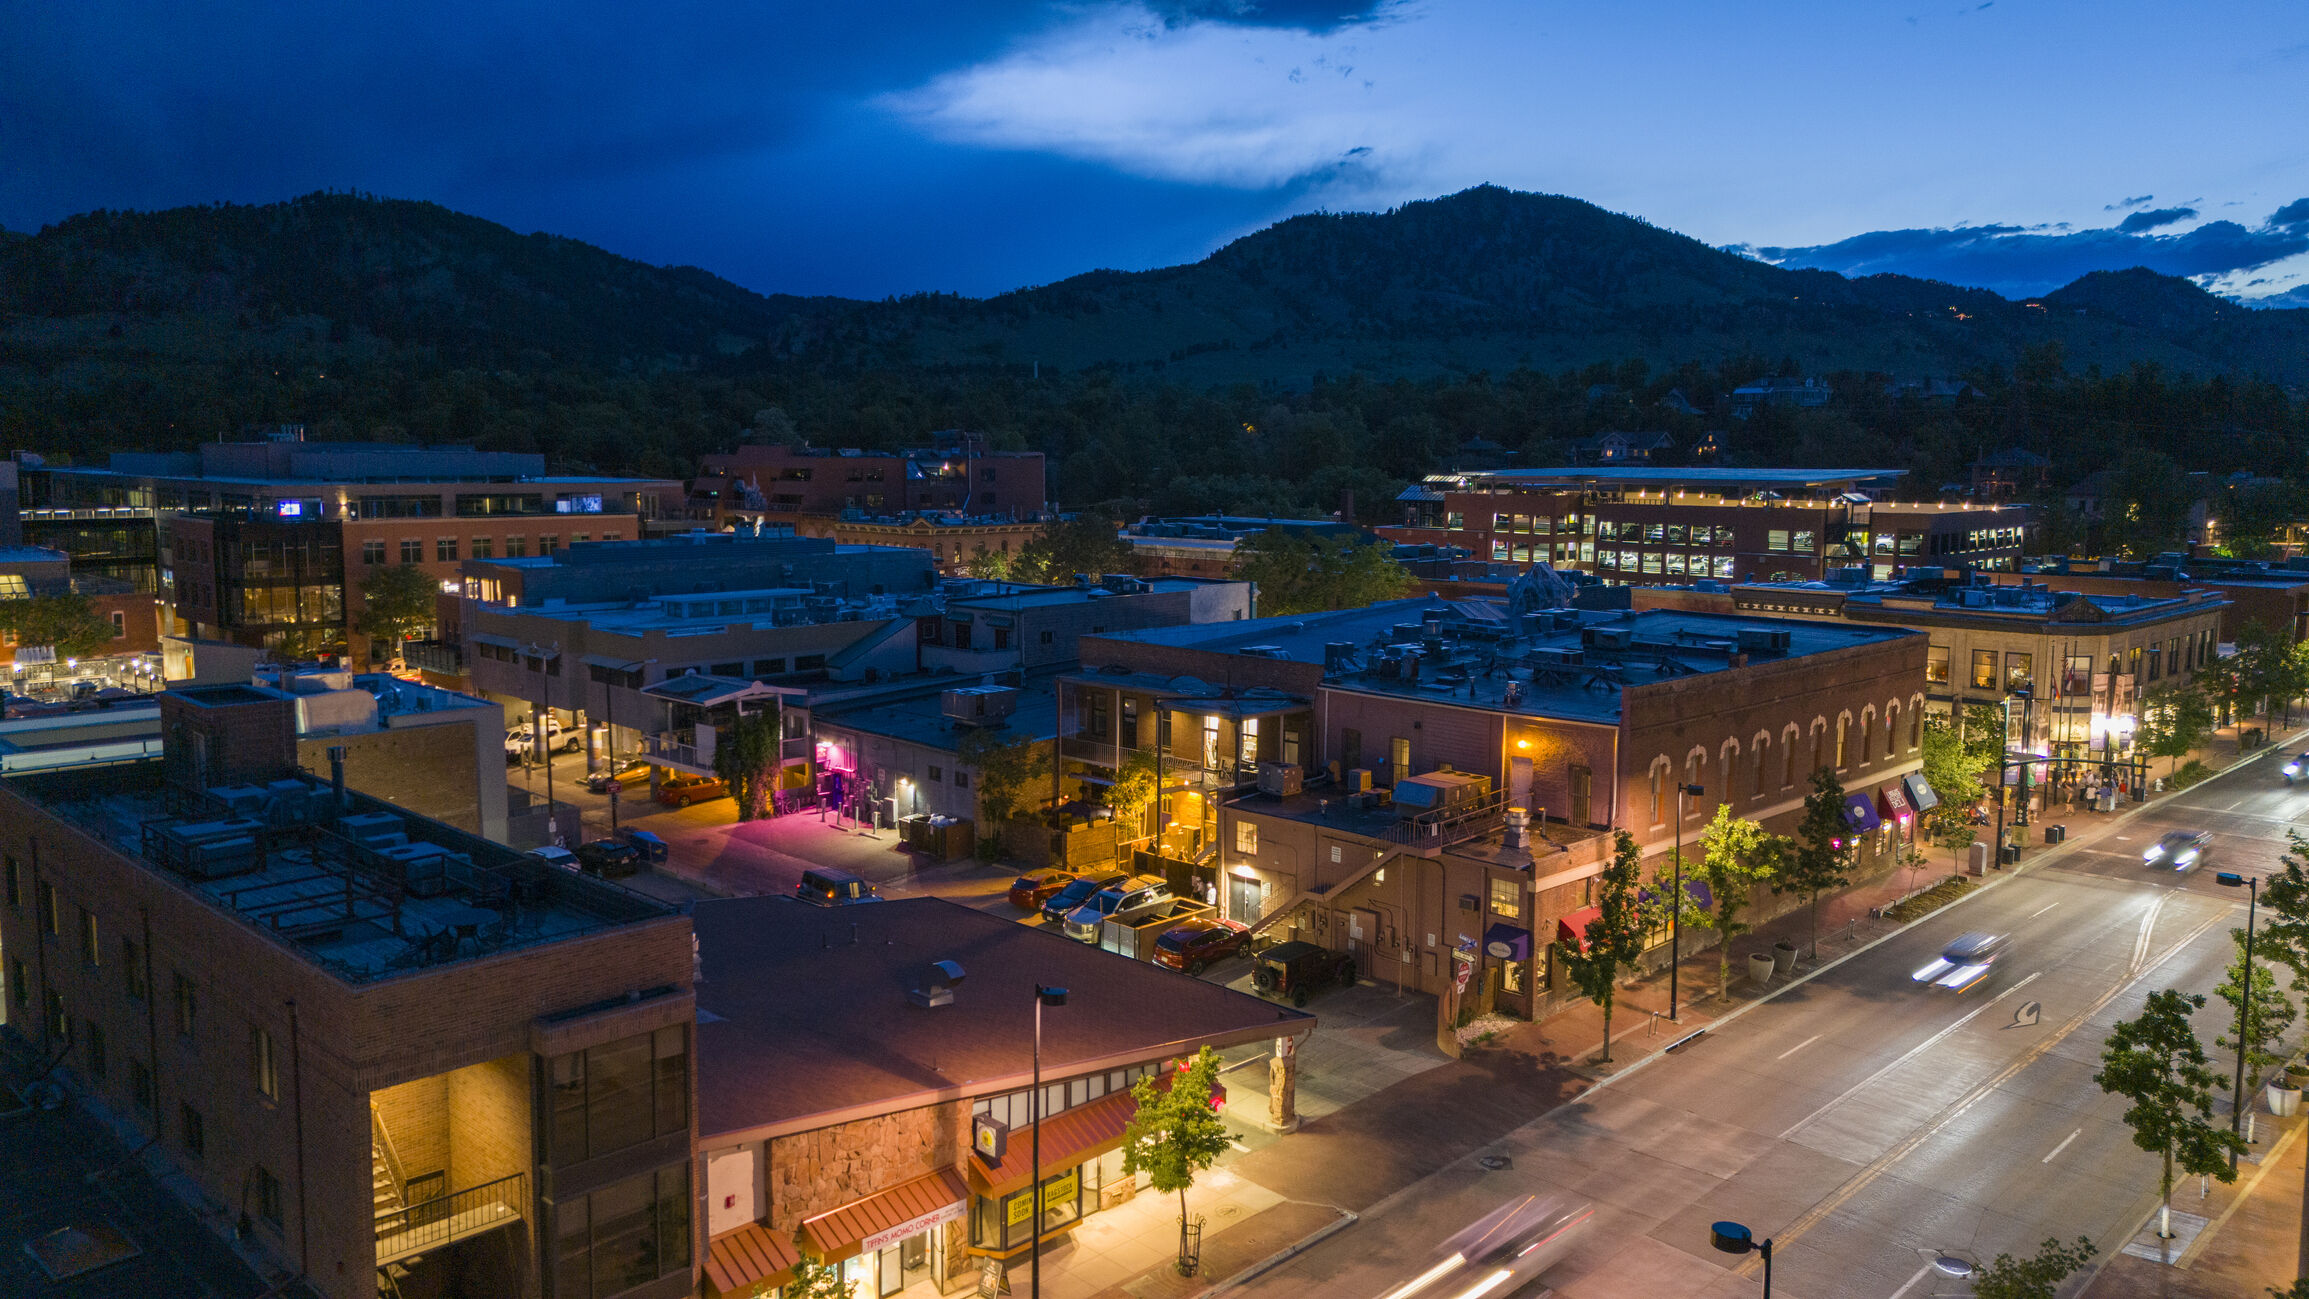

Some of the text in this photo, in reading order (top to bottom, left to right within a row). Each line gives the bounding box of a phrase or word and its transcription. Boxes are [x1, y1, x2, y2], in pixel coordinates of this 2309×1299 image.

[1013, 1196, 1032, 1211] COMIN
[1013, 1207, 1029, 1220] SOON
[866, 1213, 940, 1249] TIFFIN'S MOMO CORNER
